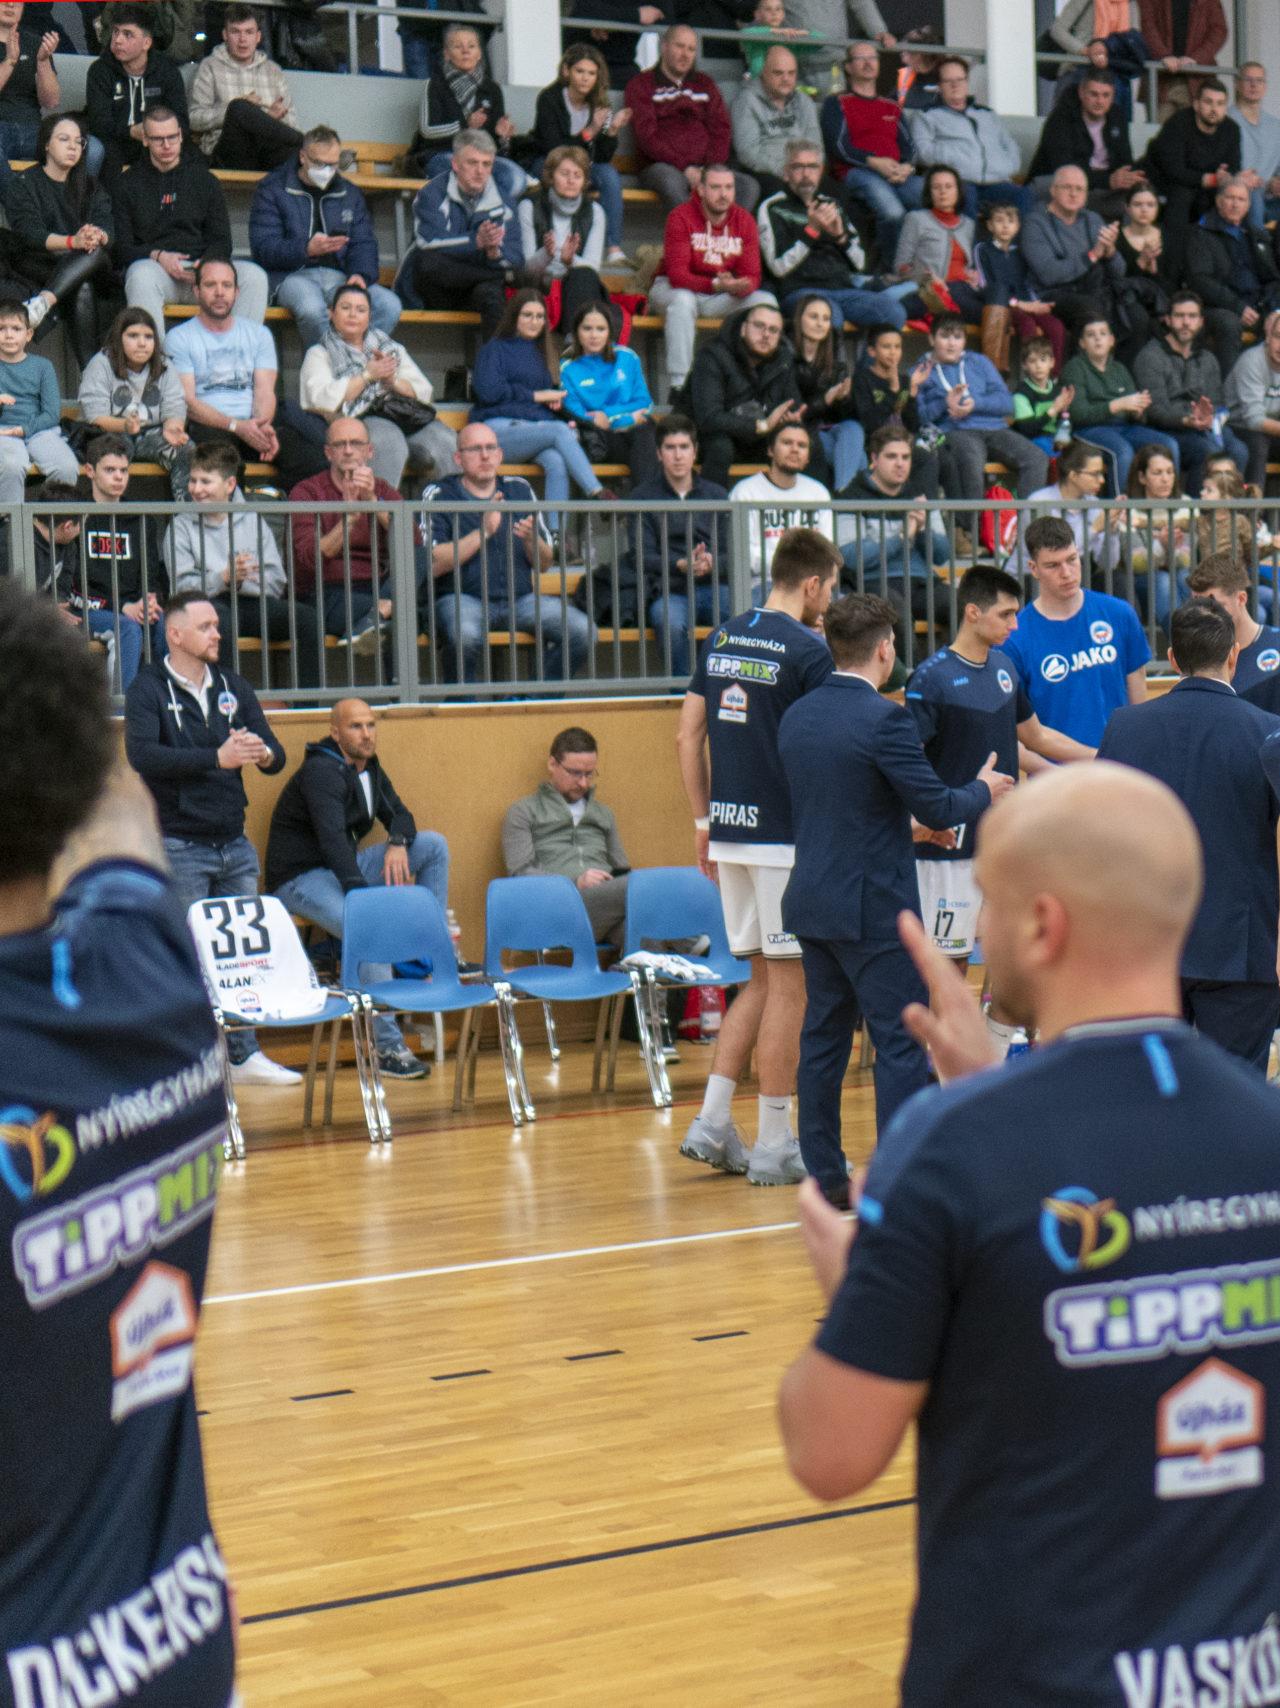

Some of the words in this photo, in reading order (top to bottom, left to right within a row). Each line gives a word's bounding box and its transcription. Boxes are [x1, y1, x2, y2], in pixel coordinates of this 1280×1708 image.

[728, 635, 786, 653] NYÍREGYHÁZA
[1071, 645, 1117, 672] JAKO
[709, 801, 759, 828] PIRAS
[202, 896, 271, 960] 33
[934, 910, 954, 937] 17
